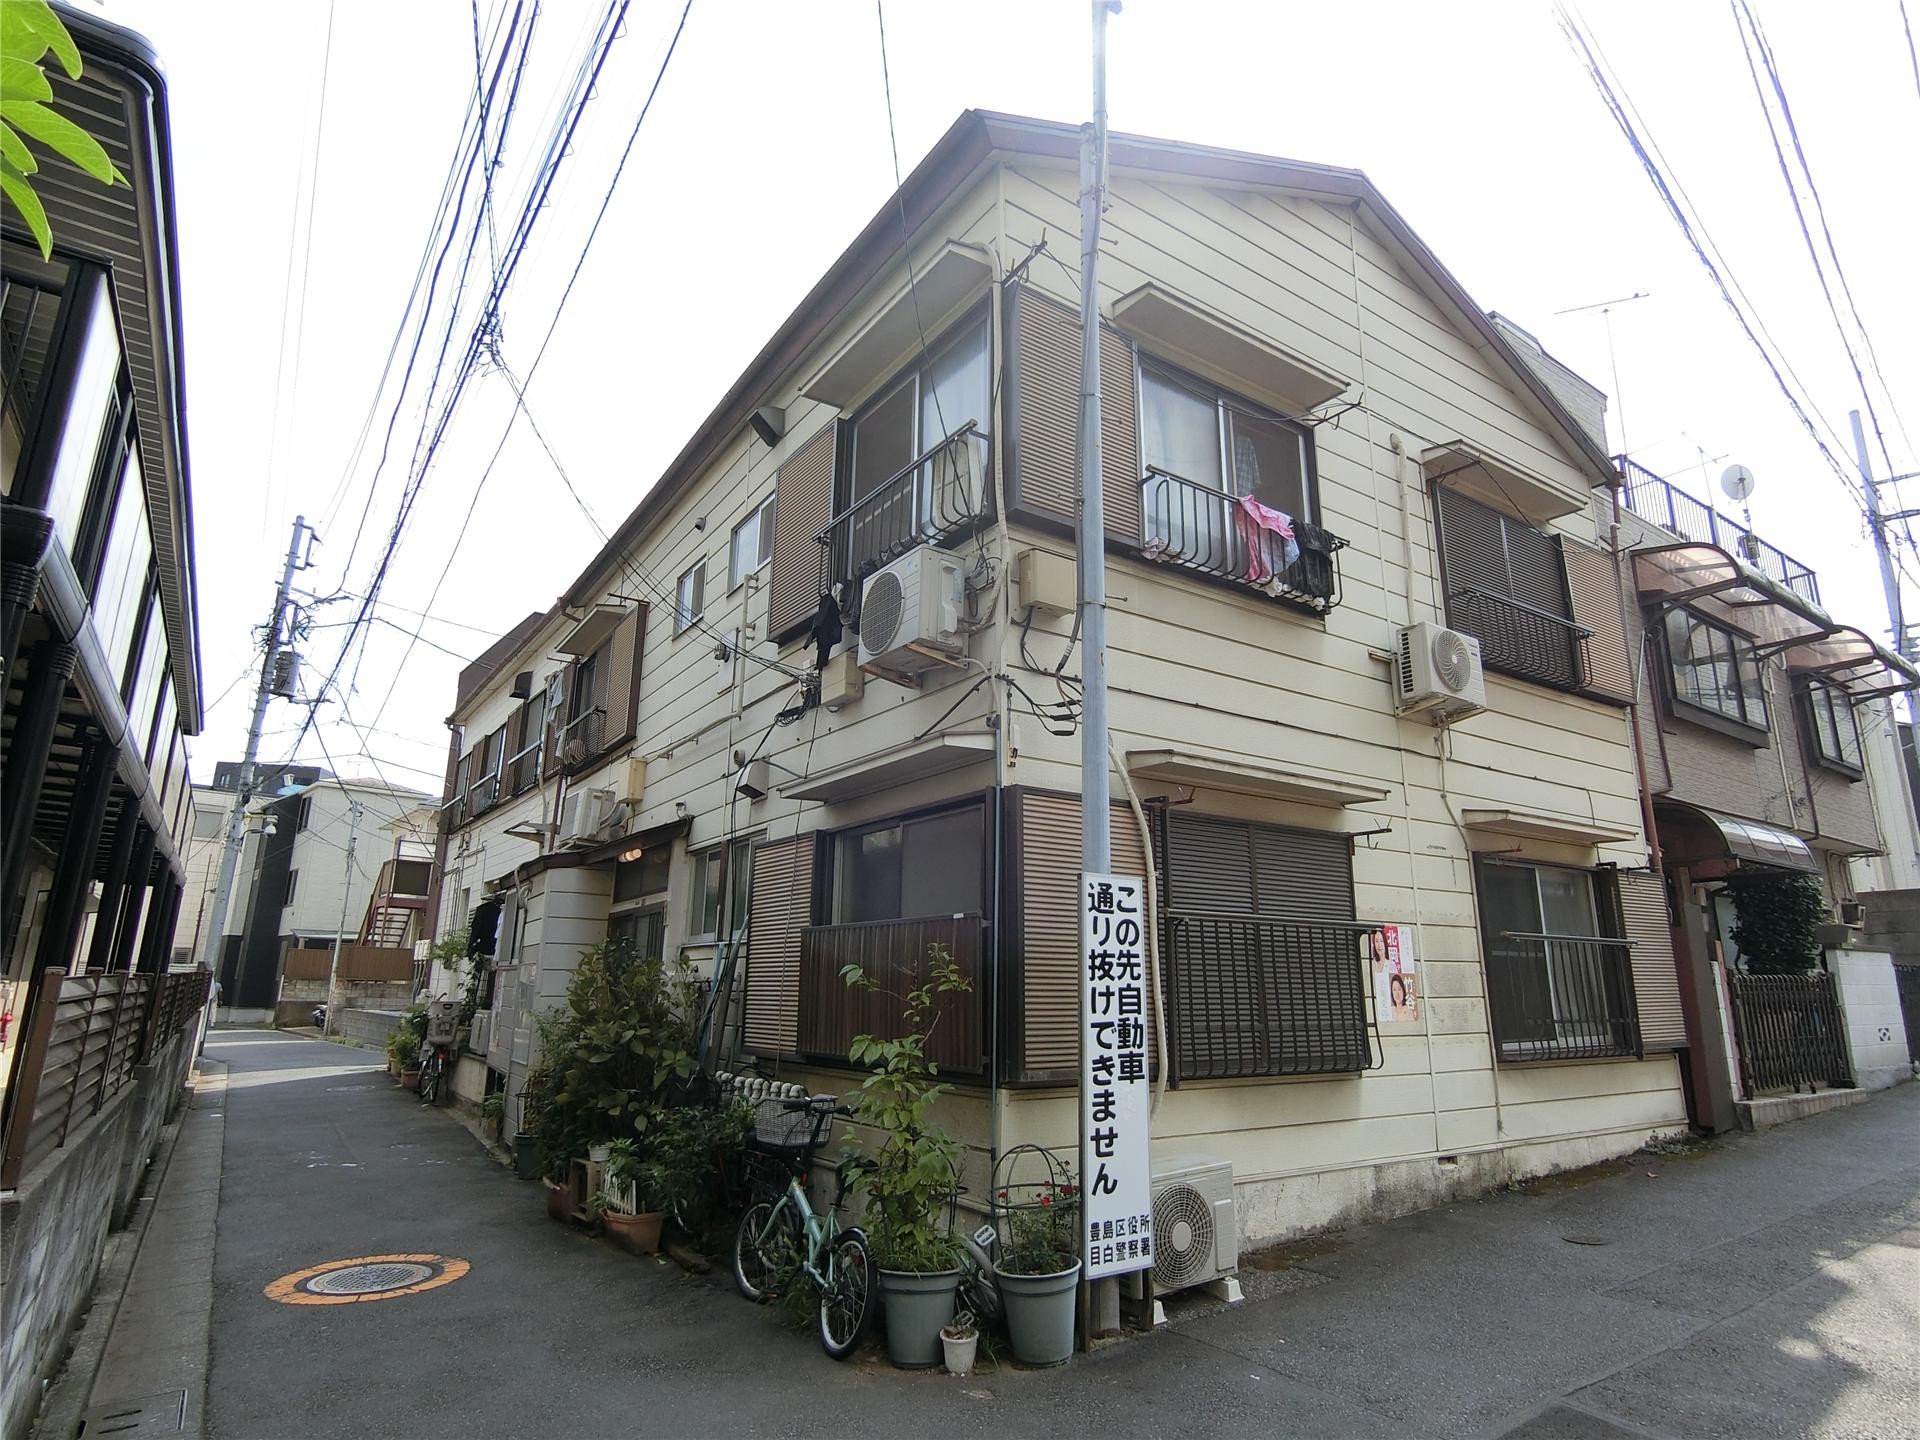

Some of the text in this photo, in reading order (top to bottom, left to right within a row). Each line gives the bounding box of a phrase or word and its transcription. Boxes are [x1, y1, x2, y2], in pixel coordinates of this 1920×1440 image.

[1087, 882, 1119, 1197] 通り抜けできません
[1115, 885, 1146, 1084] この先自動車
[1089, 1214, 1151, 1242] 豊島区役所
[1090, 1237, 1151, 1267] 目白警察署
